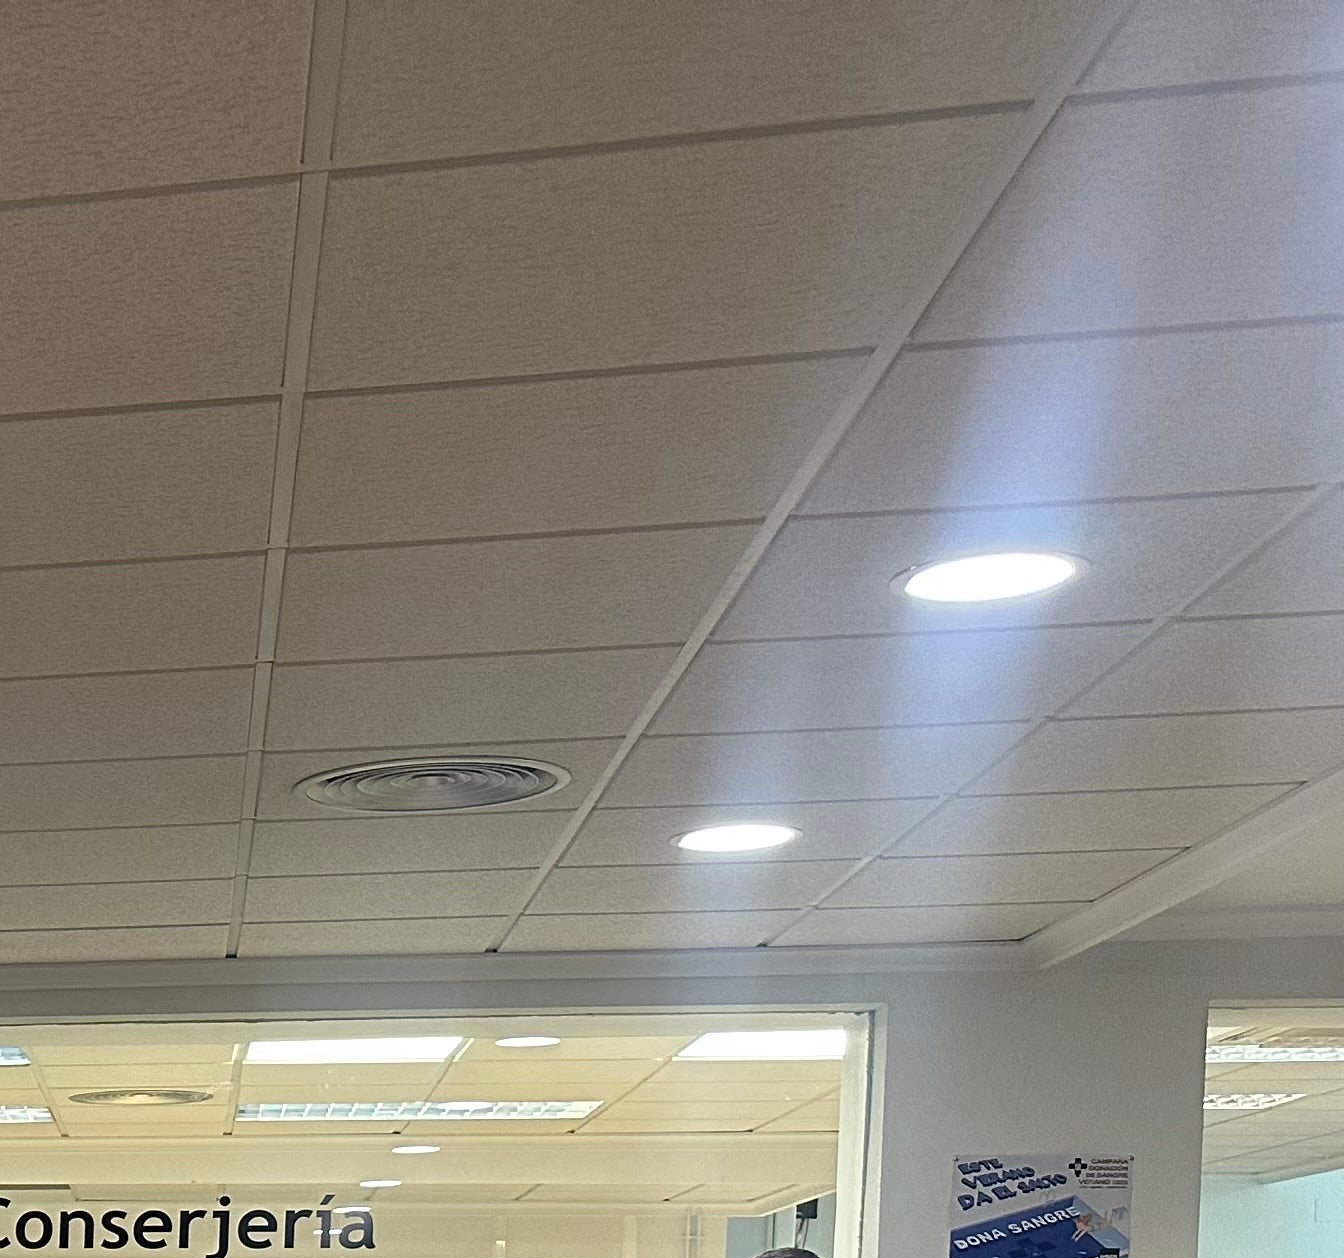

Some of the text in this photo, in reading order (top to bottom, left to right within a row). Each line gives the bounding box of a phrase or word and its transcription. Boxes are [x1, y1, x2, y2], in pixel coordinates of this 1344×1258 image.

[961, 1167, 1035, 1189] VERANO
[958, 1191, 993, 1211] DA
[953, 1206, 1081, 1250] DONA SANGRE
